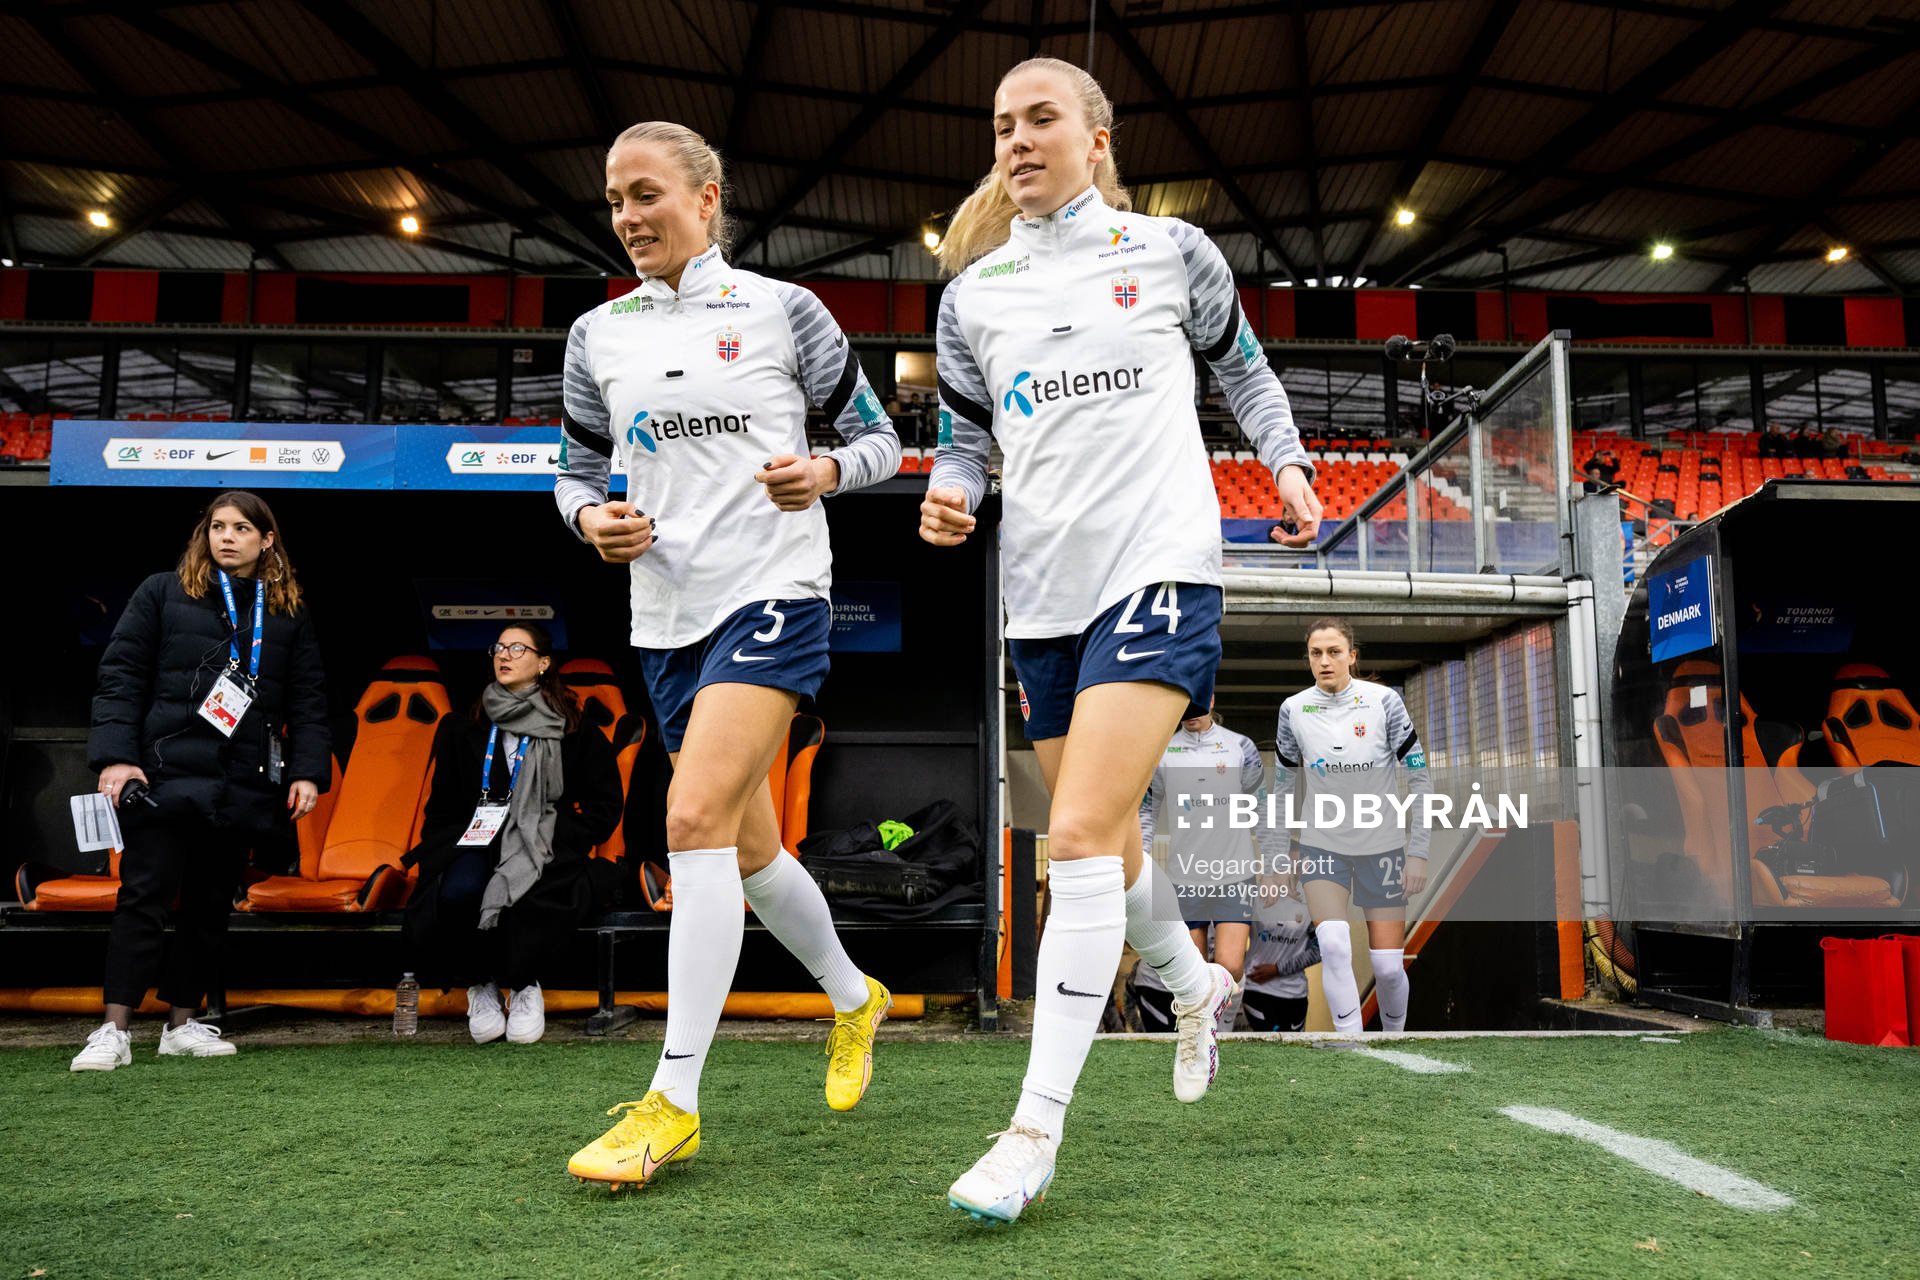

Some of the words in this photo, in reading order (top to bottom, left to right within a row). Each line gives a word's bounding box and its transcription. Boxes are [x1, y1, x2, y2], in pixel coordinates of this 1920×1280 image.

[1073, 193, 1095, 212] telenor
[1098, 249, 1119, 260] Norsk
[1120, 243, 1147, 255] Tipping
[641, 304, 654, 313] pris
[706, 302, 726, 310] Norsk
[727, 301, 751, 309] Tipping
[1031, 367, 1144, 404] telenor
[651, 412, 752, 442] telenor
[278, 447, 301, 456] Uber
[278, 456, 301, 464] Eats
[1113, 581, 1182, 635] 24
[1786, 607, 1834, 615] TOURNOI
[1658, 602, 1702, 631] DENMARK
[1776, 616, 1790, 624] DE
[1793, 616, 1835, 624] FRANCE
[1325, 759, 1375, 774] telenor
[1379, 856, 1403, 886] 25
